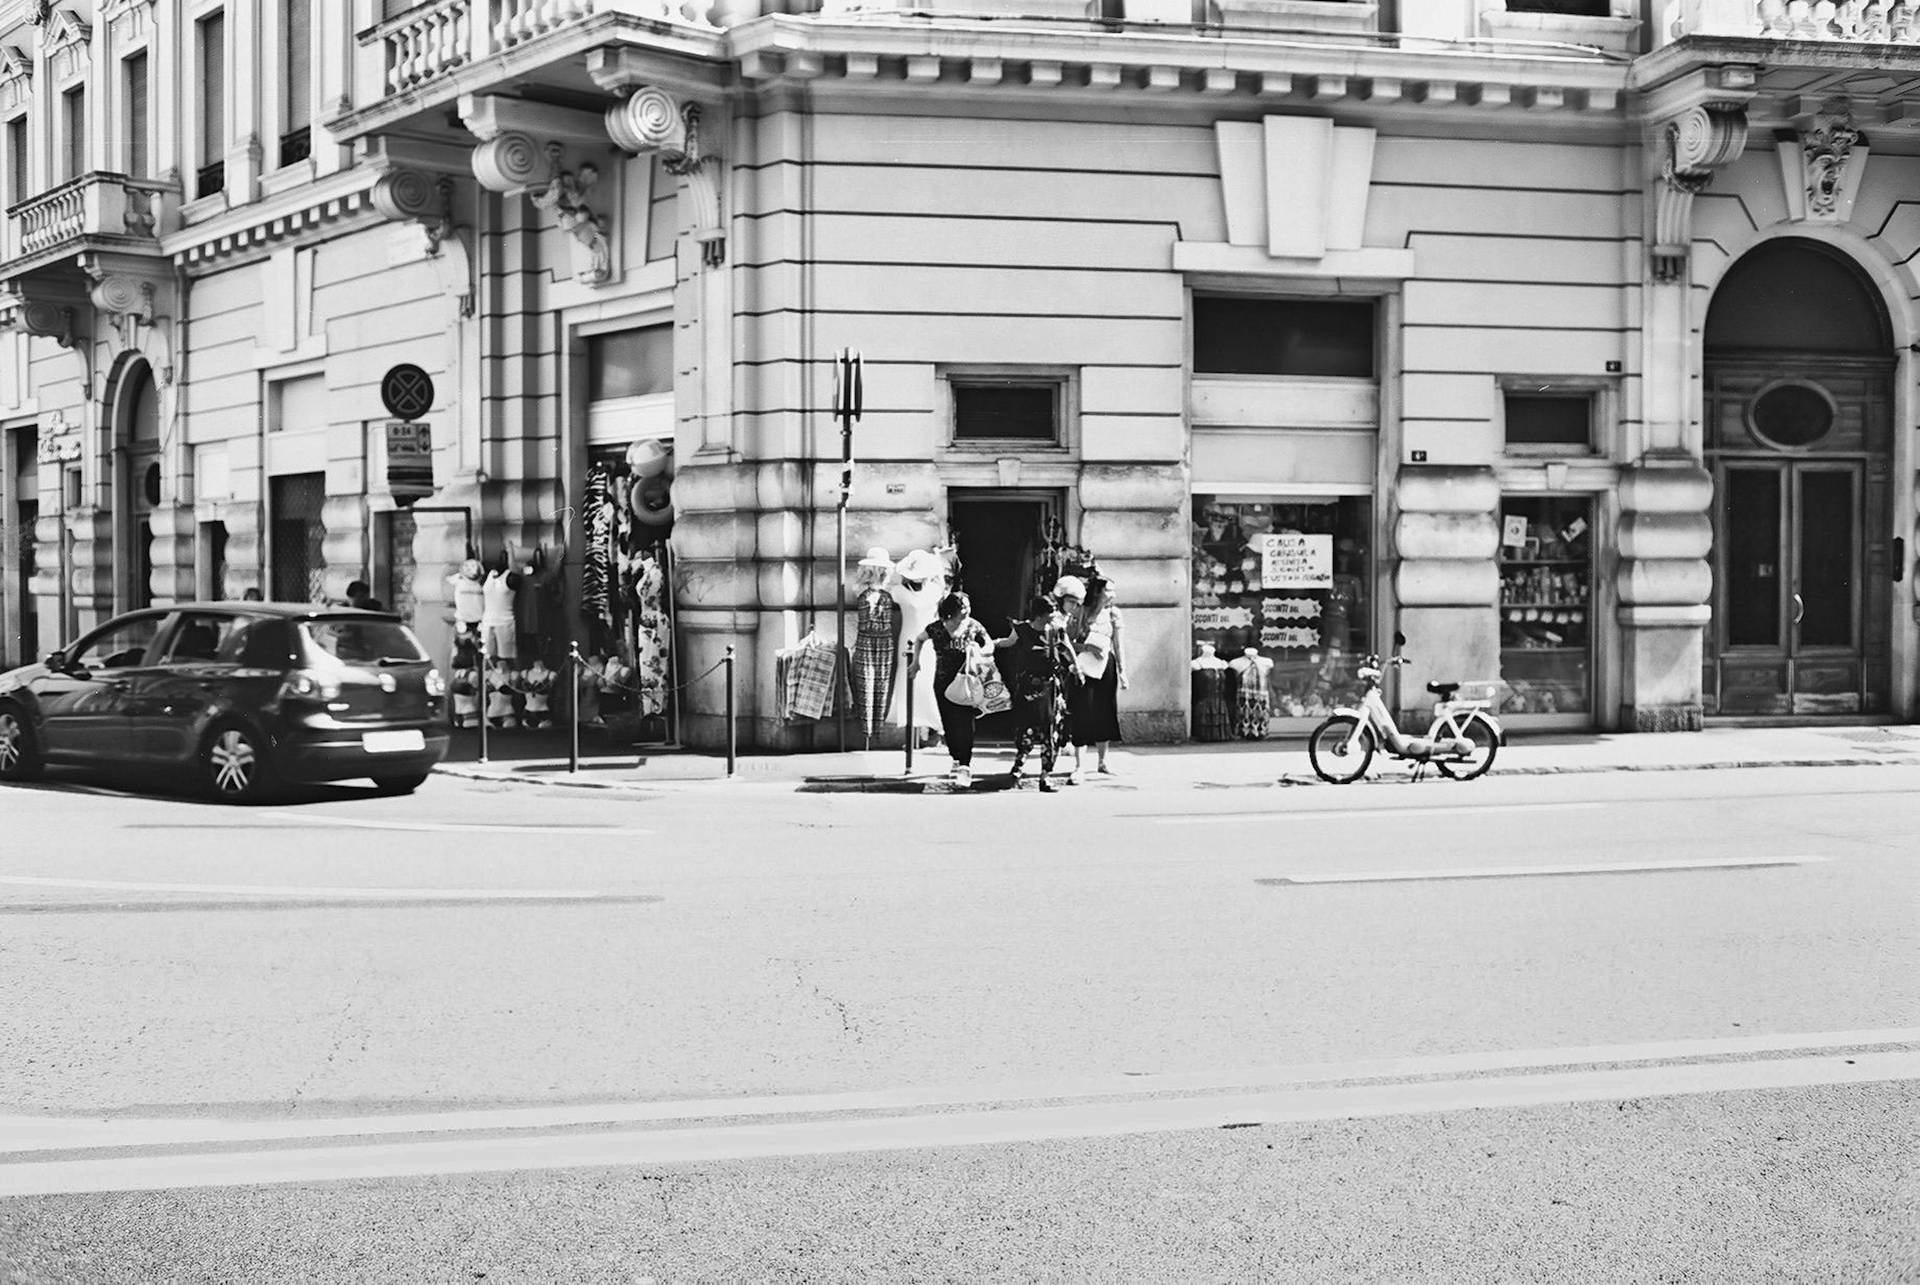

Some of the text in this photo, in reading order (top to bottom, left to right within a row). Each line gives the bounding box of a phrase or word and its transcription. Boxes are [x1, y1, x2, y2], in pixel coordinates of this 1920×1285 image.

[1264, 603, 1289, 613] SCONTI
[1194, 613, 1219, 624] SCONTI
[1262, 631, 1287, 641] SCONTI
